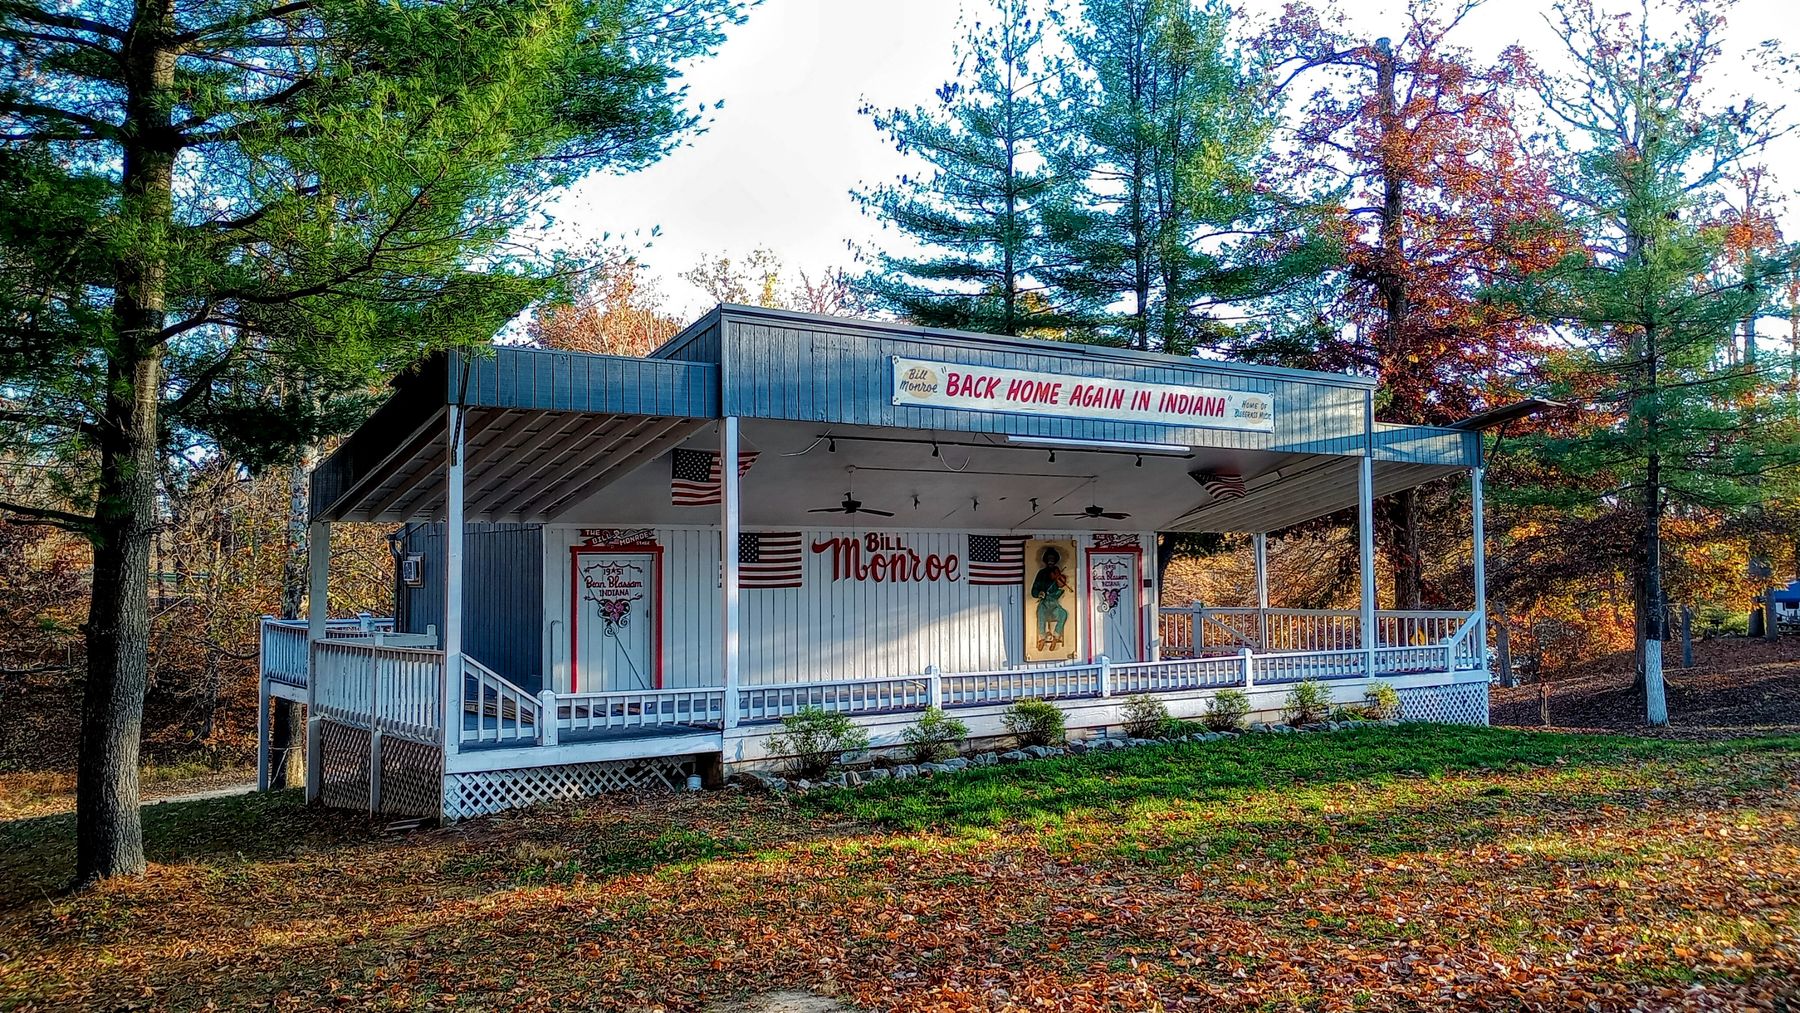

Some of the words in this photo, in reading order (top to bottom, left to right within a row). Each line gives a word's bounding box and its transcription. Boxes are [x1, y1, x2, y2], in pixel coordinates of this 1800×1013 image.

[908, 368, 928, 380] Bill
[899, 379, 938, 393] Monroe
[1006, 378, 1062, 405] HOME
[1069, 384, 1125, 410] AGAIN
[1130, 389, 1152, 411] IN
[1241, 400, 1259, 410] HOME
[1260, 402, 1268, 411] OF
[592, 533, 612, 545] BILL
[811, 536, 961, 583] Monroe
[584, 575, 606, 588] Bean
[599, 589, 629, 597] INDIANA
